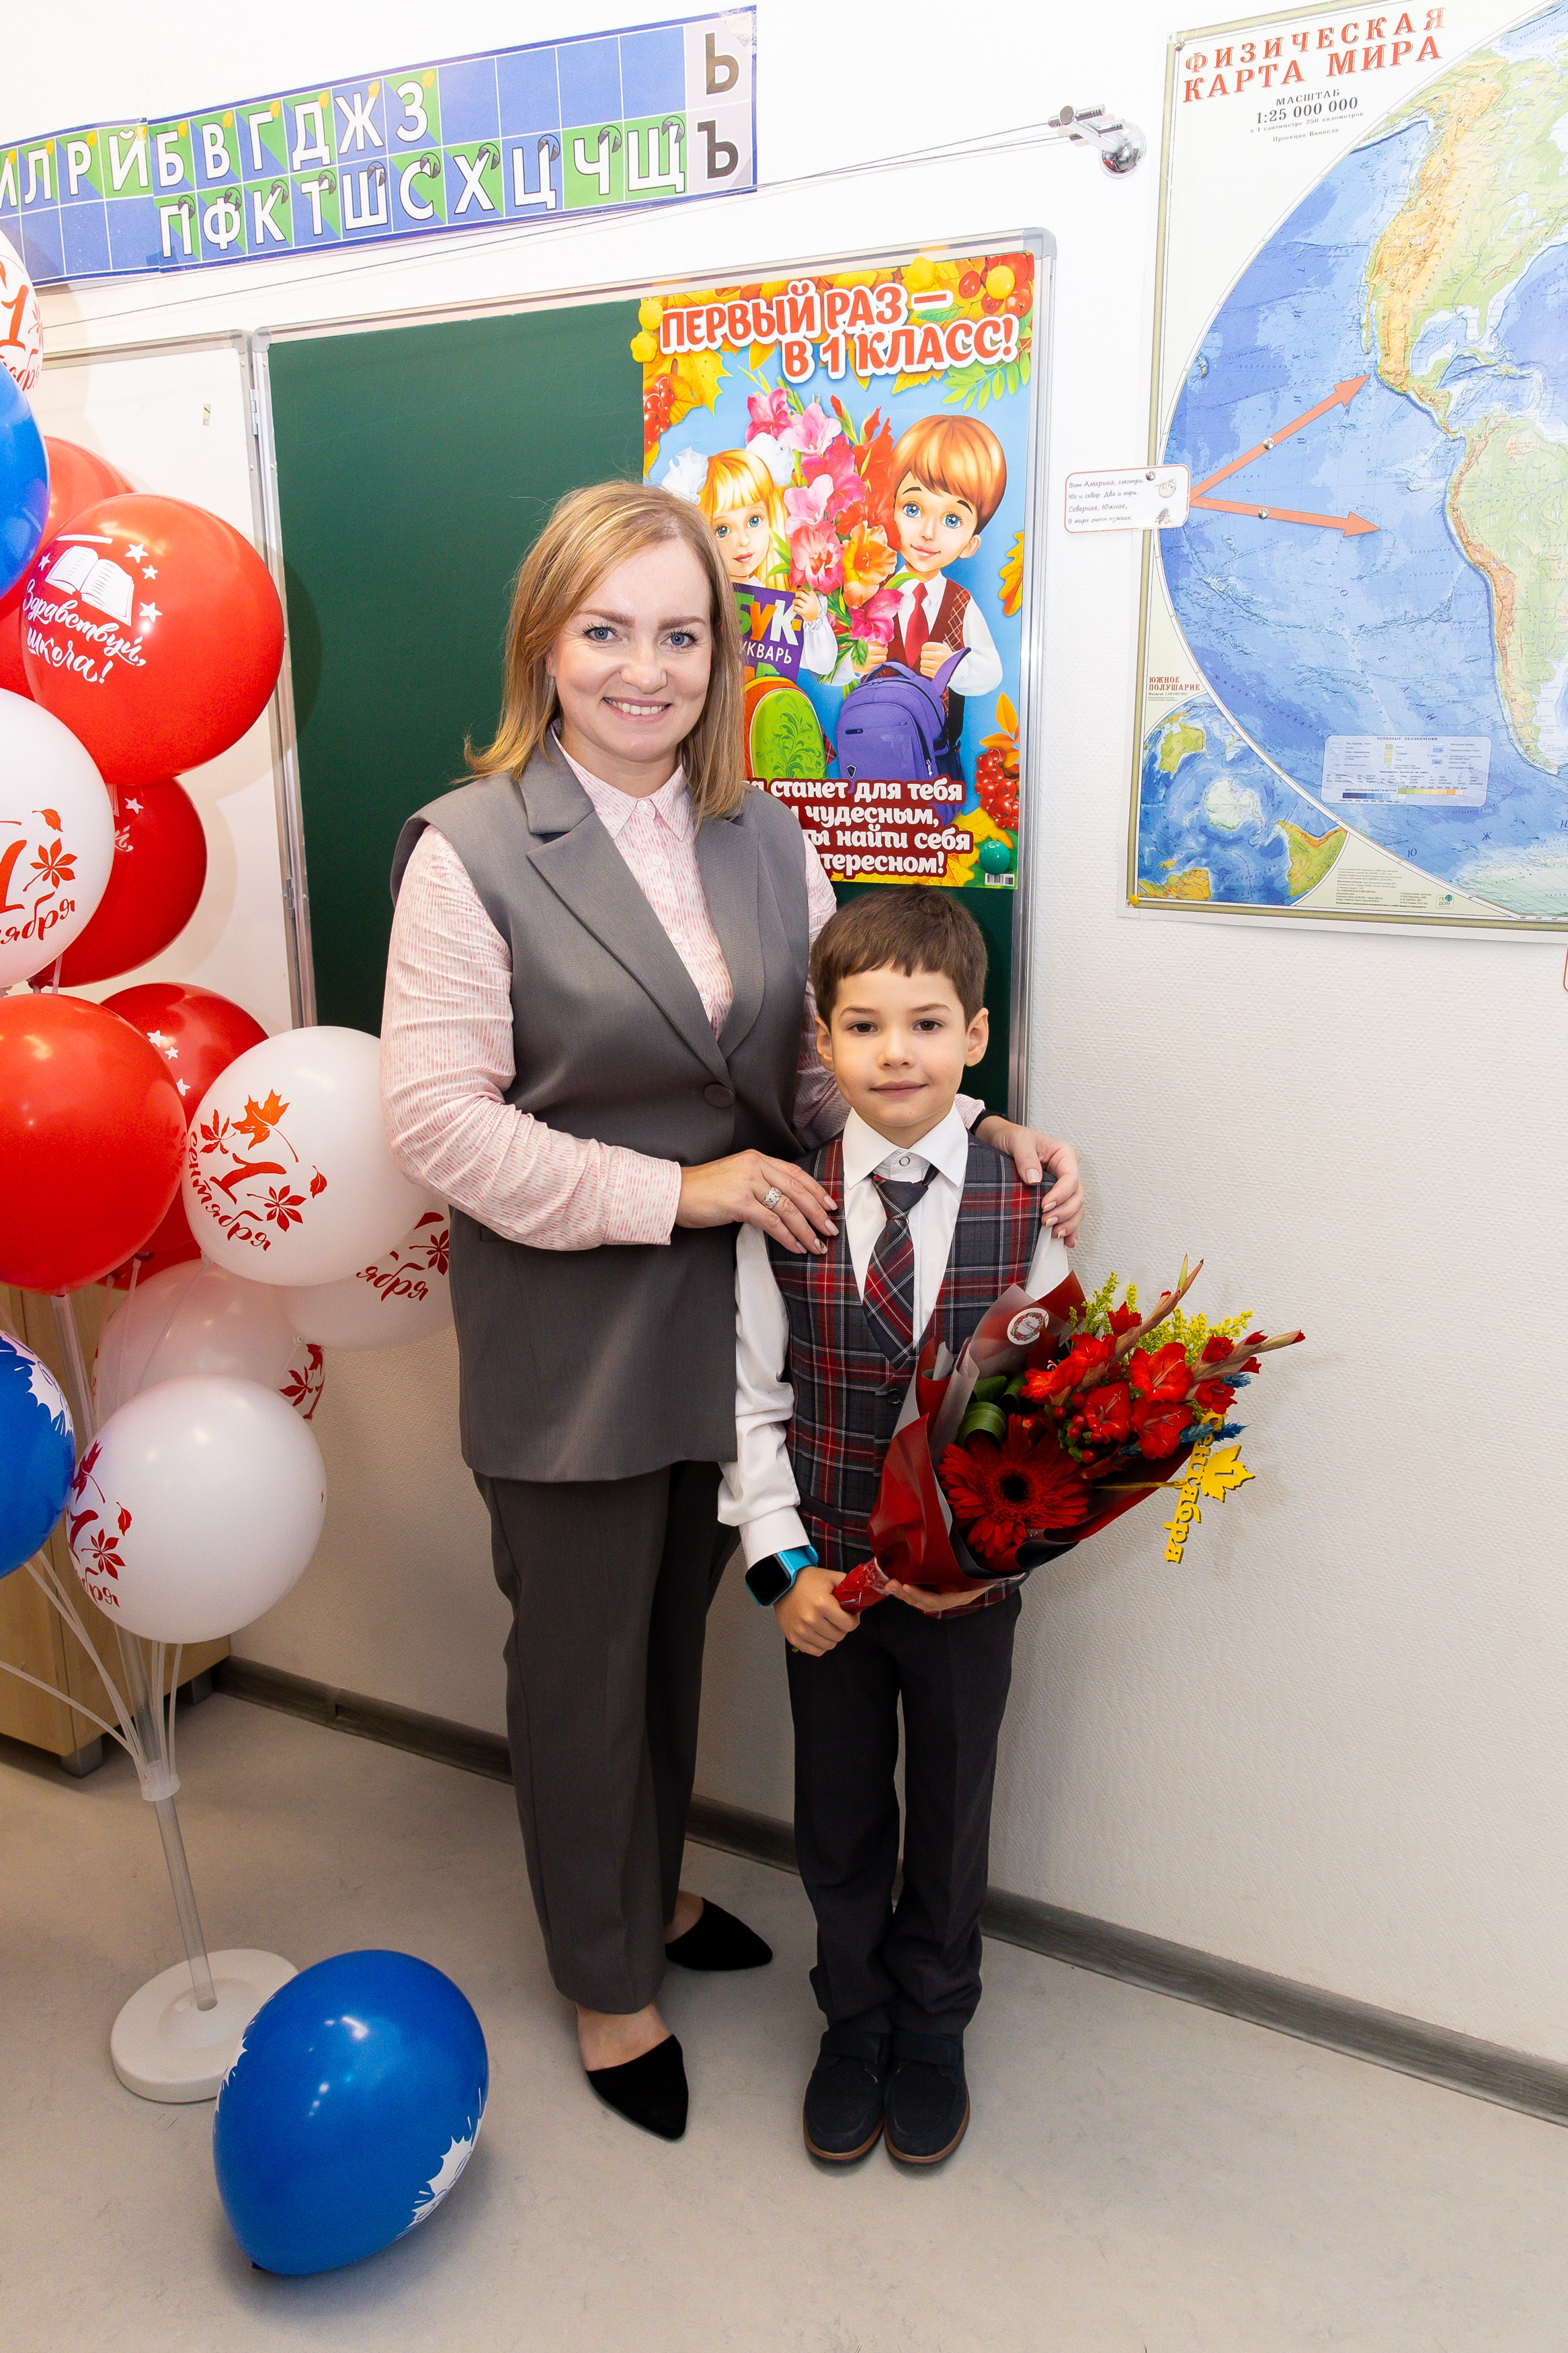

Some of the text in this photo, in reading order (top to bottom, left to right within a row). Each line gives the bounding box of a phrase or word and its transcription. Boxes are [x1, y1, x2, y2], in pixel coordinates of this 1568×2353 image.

[1186, 7, 1446, 73] ФИЗИЧЕСКАЯ
[1183, 36, 1442, 104] КАРТА МИРА
[1257, 97, 1358, 124] 1:25 000 000
[1276, 89, 1340, 106] МАСШТАБ
[662, 283, 815, 348] ПЕРВЫЙ
[826, 286, 903, 329] РАЗ
[785, 317, 1014, 377] В 1 КЛАСС!
[1069, 505, 1100, 513] Северная,
[23, 579, 147, 666] Здравствуй,
[27, 627, 114, 684] школа!
[770, 781, 848, 798] станет
[854, 783, 901, 801] для
[909, 779, 962, 799] тебя
[805, 805, 939, 827] чудесным,
[837, 824, 908, 848] найти
[914, 827, 970, 849] себя
